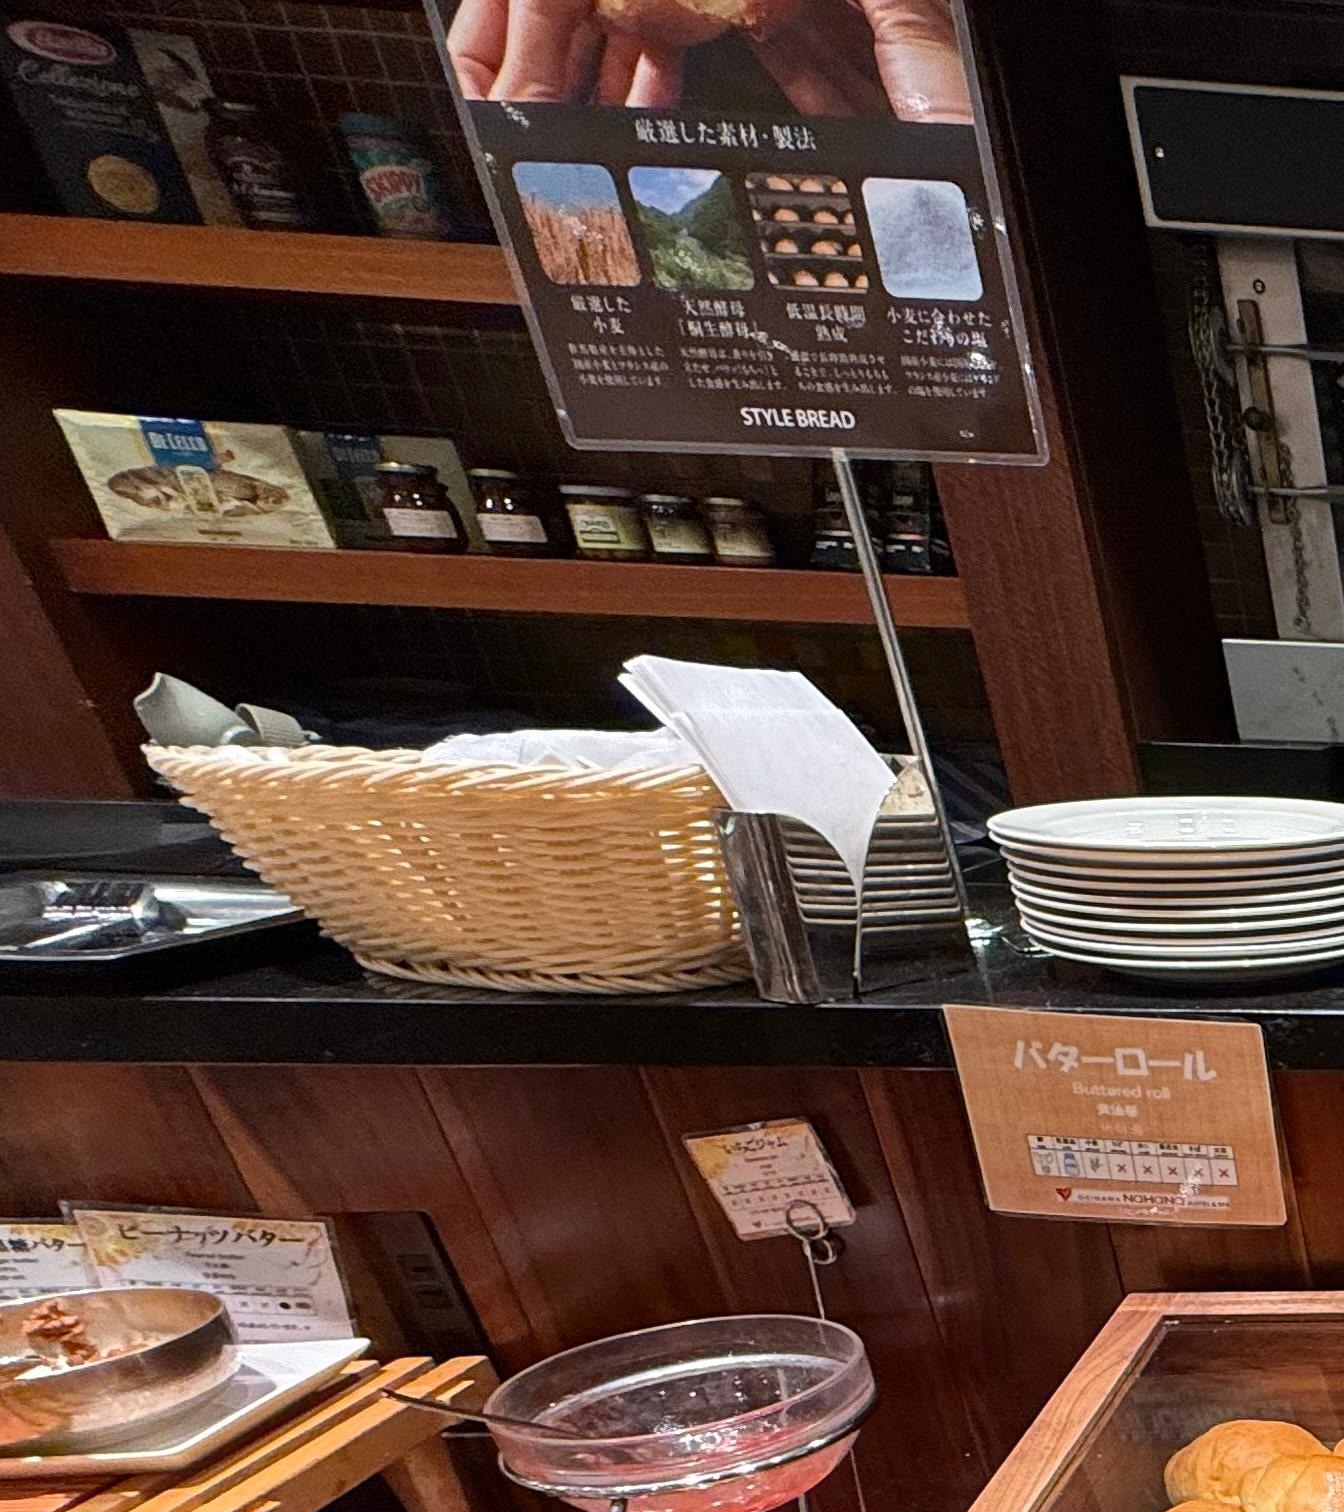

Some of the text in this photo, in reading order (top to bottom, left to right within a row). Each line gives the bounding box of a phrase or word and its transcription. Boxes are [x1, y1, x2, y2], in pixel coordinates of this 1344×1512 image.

[634, 117, 817, 151] 厳選した素材・製法
[740, 407, 856, 429] STYLE BREAD
[1014, 1039, 1217, 1082] バターロール
